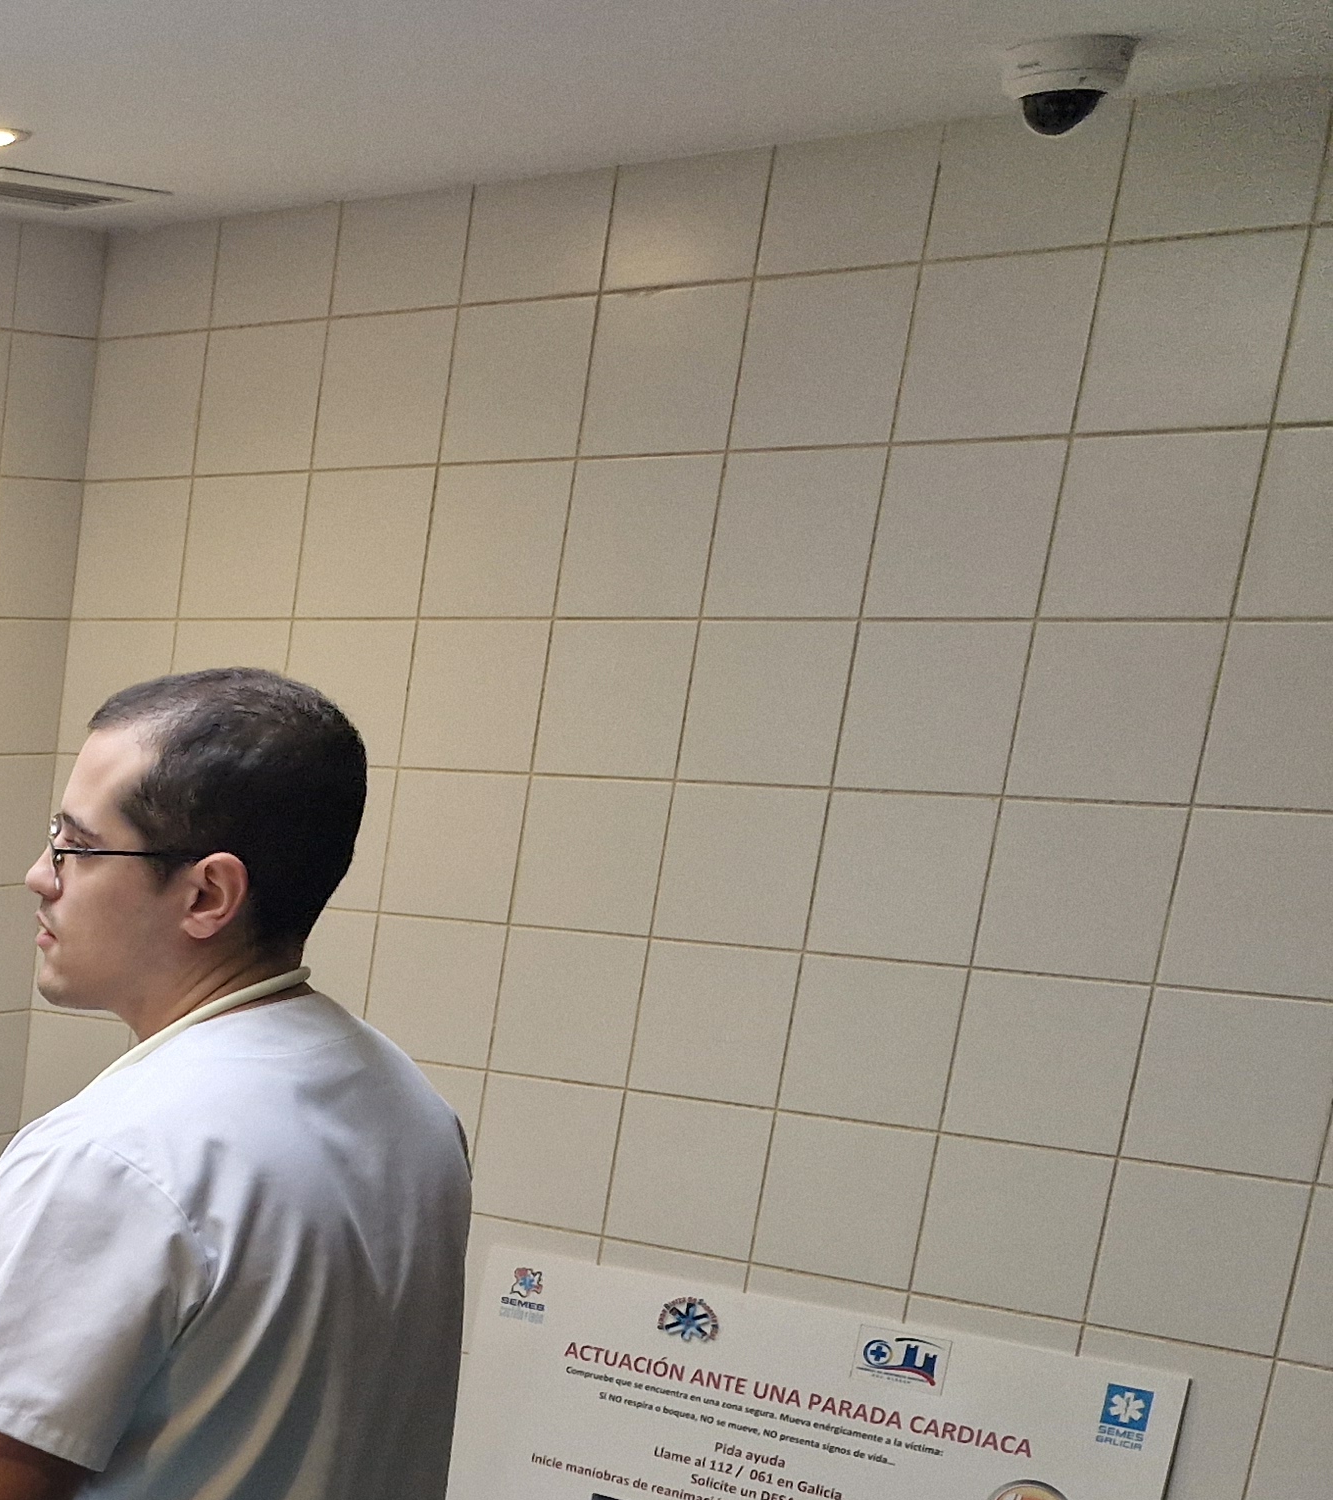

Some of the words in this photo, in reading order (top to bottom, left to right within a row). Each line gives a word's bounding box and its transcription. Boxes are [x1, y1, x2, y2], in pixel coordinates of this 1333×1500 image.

[563, 1336, 686, 1382] ACTUACIÓN
[689, 1367, 748, 1396] ANTE
[752, 1380, 803, 1408] UNA
[807, 1392, 903, 1430] PARADA
[908, 1413, 1035, 1458] CARDIACA
[1094, 1434, 1143, 1452] GALICIA
[1096, 1424, 1145, 1443] SEMES
[714, 1440, 742, 1457] Pida
[744, 1448, 786, 1470] ayuda
[531, 1452, 563, 1469] Inicie
[565, 1460, 630, 1486] maniobras
[632, 1477, 648, 1490] de
[653, 1445, 692, 1464] Llame
[694, 1455, 706, 1467] al
[709, 1458, 733, 1474] 112
[735, 1465, 743, 1479] /
[749, 1468, 772, 1484] 061
[776, 1478, 793, 1489] en
[796, 1480, 843, 1500] Galicia
[690, 1473, 737, 1494] Solicite
[739, 1488, 757, 1499] un
